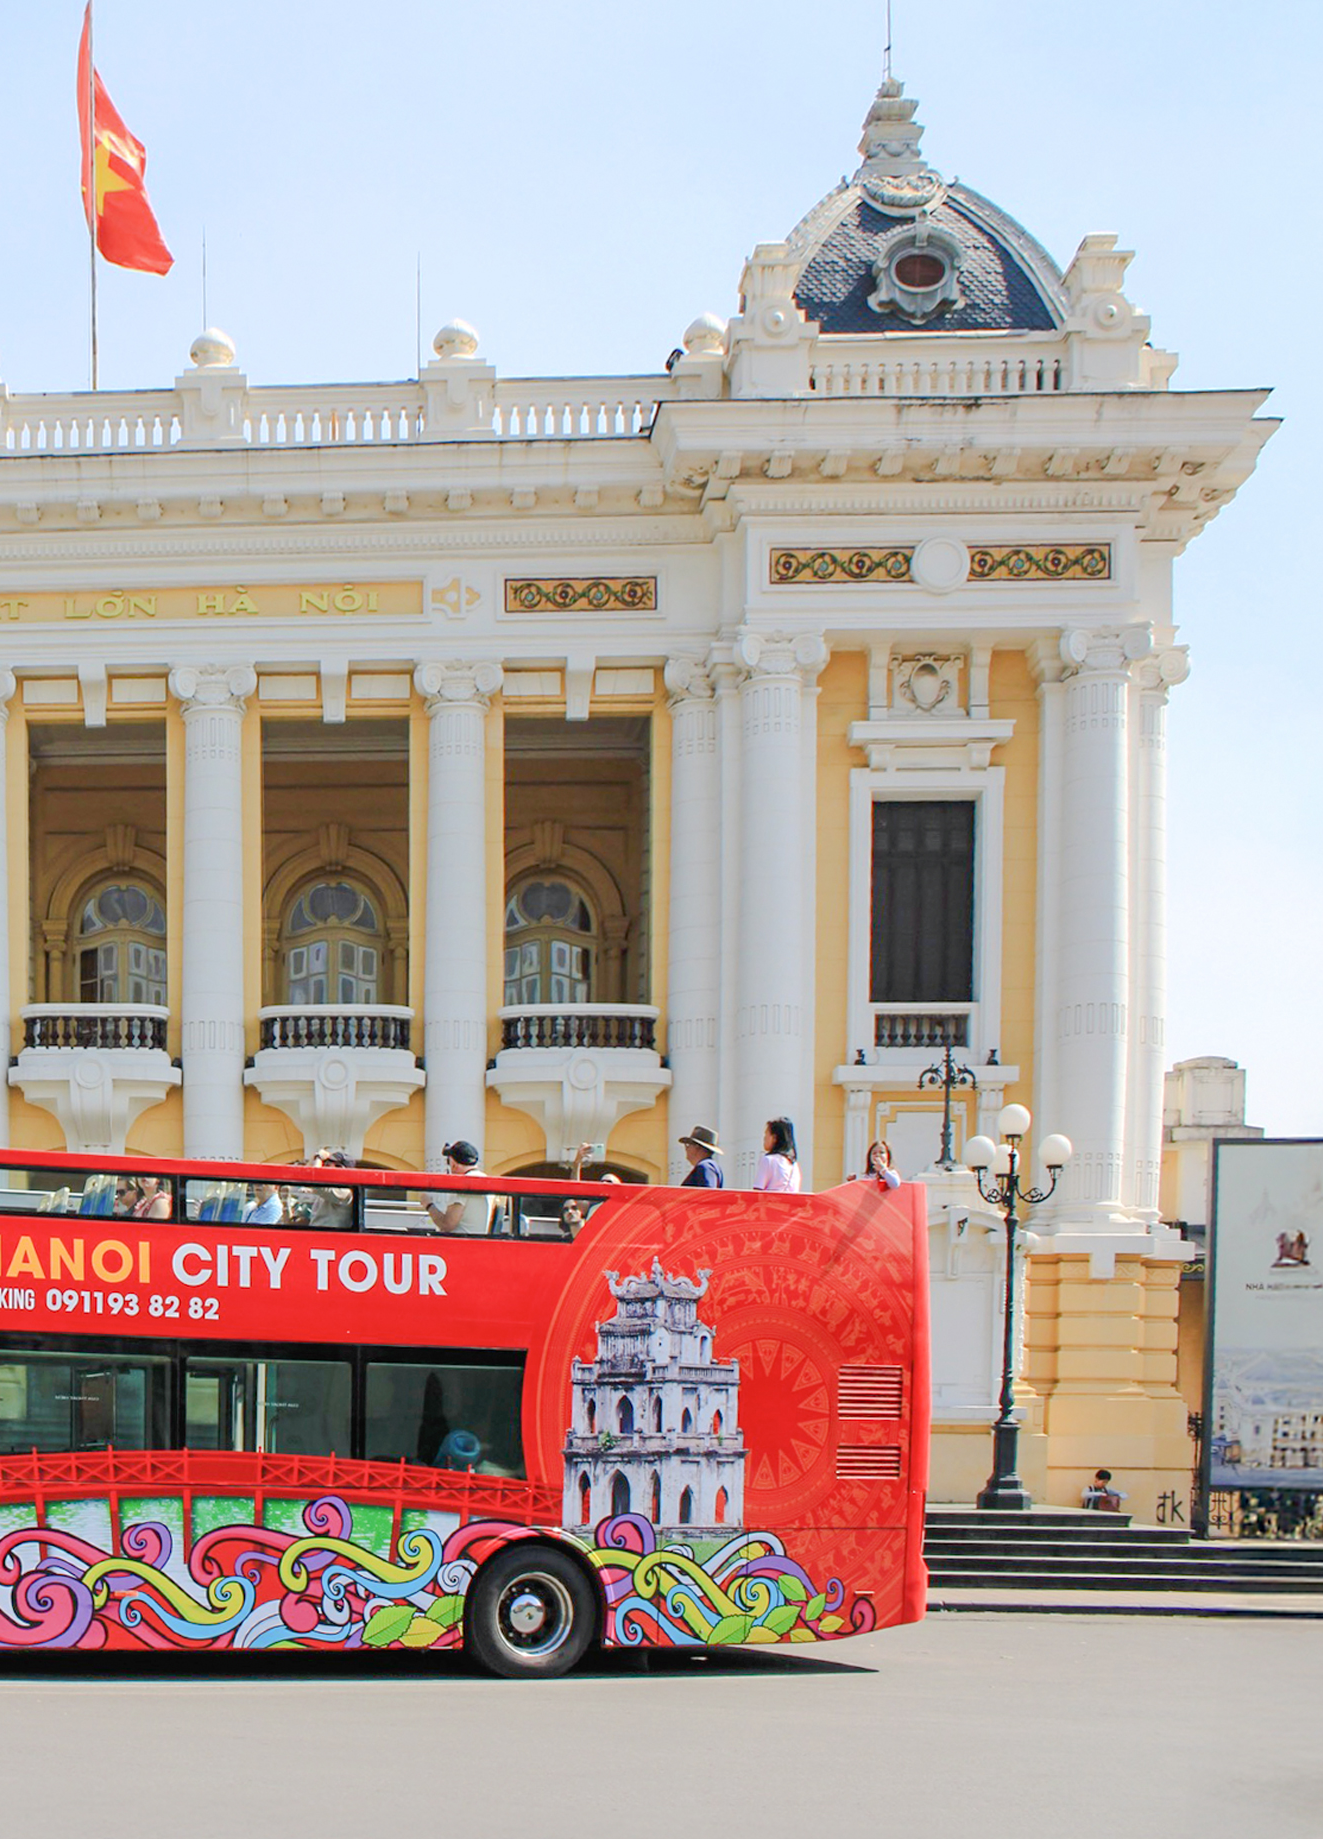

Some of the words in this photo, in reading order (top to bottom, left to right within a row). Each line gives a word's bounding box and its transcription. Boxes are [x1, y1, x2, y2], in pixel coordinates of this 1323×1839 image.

[63, 589, 157, 619] LỚN
[197, 584, 259, 615] HÀ
[299, 584, 378, 616] NỘI
[172, 1243, 292, 1289] CITY
[310, 1249, 448, 1296] TOUR
[46, 1288, 140, 1316] 091193
[148, 1294, 180, 1318] 82
[188, 1297, 220, 1320] 82
